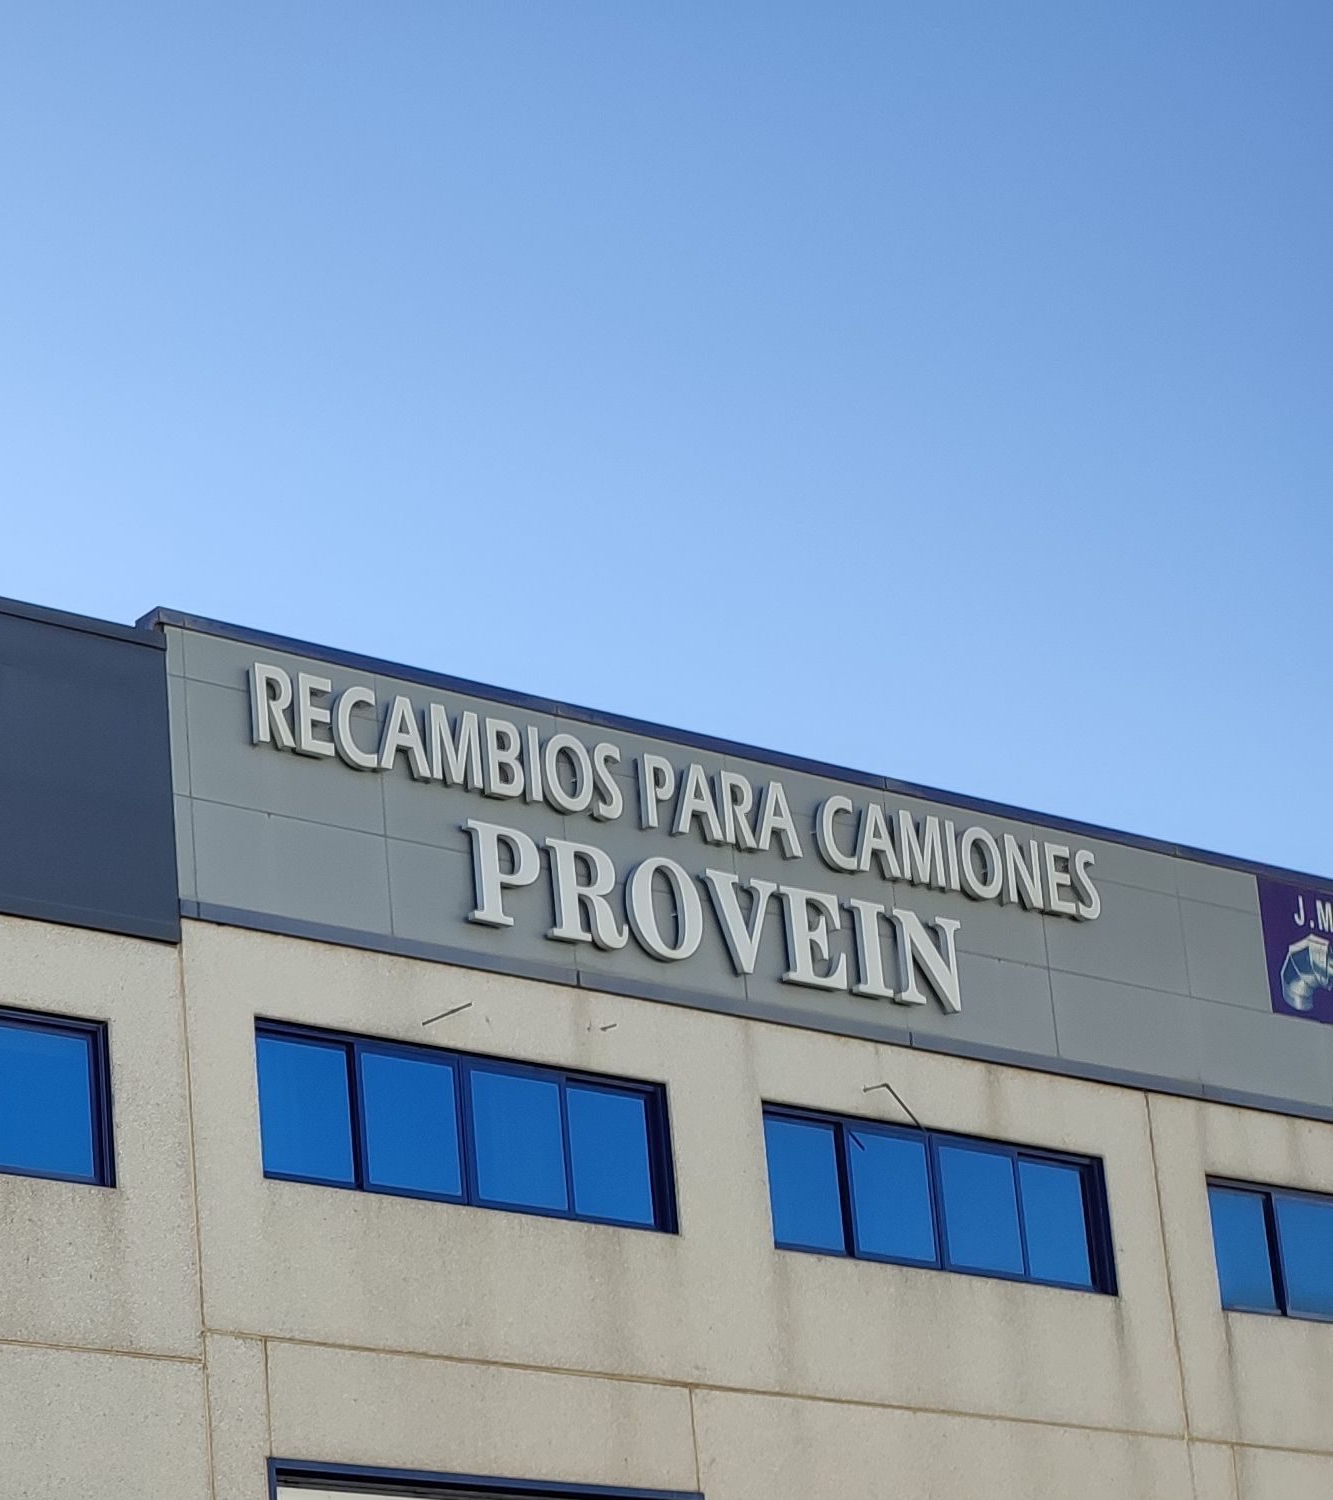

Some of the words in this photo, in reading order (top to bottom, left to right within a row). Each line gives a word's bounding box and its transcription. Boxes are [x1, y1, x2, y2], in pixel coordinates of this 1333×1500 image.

[247, 661, 625, 823] RECAMBIOS
[635, 752, 804, 861] PARA
[816, 794, 1102, 922] CAMIONES
[461, 817, 962, 1015] PROVEIN
